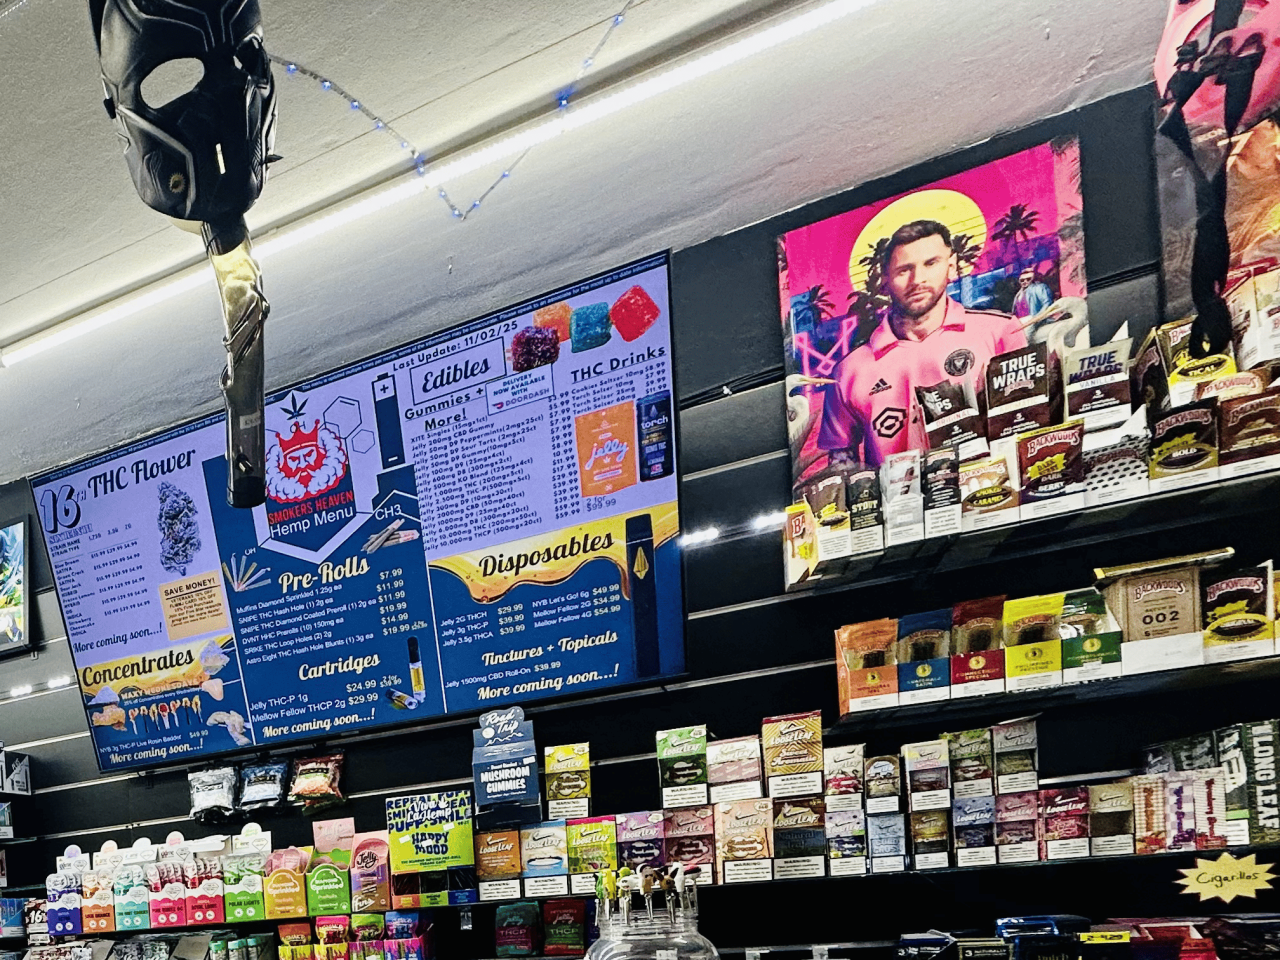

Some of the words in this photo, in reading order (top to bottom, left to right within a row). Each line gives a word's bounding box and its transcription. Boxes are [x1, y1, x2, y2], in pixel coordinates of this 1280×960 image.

[393, 360, 416, 372] Last
[418, 343, 461, 364] Update:
[464, 320, 518, 350] 11/02/25
[571, 360, 604, 383] THC
[610, 346, 666, 369] Drinks
[999, 350, 1038, 379] TRUE
[1078, 349, 1117, 371] TRUE
[422, 357, 490, 394] Edibles
[993, 361, 1046, 394] WRAPS
[404, 392, 470, 420] Gummies
[424, 408, 467, 432] More!
[1156, 409, 1212, 437] BACKWOODS
[1027, 429, 1081, 458] BACKWOODS
[87, 472, 129, 499] THC
[130, 449, 196, 486] Flower
[268, 501, 313, 524] SMOKERS
[316, 491, 354, 511] HEAVEN
[375, 504, 402, 520] CH3
[852, 500, 878, 511] STOUT
[270, 518, 311, 538] Hemp
[315, 507, 354, 524] Menu
[478, 532, 615, 577] Disposables
[164, 586, 183, 597] SAVE
[185, 577, 216, 592] MONEY!
[278, 556, 370, 593] Pre-Rolls
[376, 579, 404, 592] $11.99
[378, 590, 406, 603] $11.99
[593, 583, 620, 596] $49.99
[1133, 579, 1187, 601] BACKWOODS
[1206, 576, 1265, 601] BACKWOODS
[381, 613, 408, 626] $14.99
[1141, 610, 1180, 627] 002
[73, 637, 96, 654] More
[97, 629, 128, 649] coming
[482, 645, 544, 666] Tinctures
[557, 630, 618, 652] Topicals
[82, 648, 195, 687] Concentrates
[299, 653, 380, 681] Cartridges
[268, 695, 295, 707] THC-P
[346, 680, 376, 692] $24.99
[477, 685, 510, 701] More
[513, 678, 564, 695] coming
[252, 712, 279, 724] Mellow
[281, 705, 306, 717] Fellow
[308, 701, 332, 712] THCP
[348, 693, 378, 705] $29.99
[485, 710, 515, 727] Road
[263, 724, 289, 738] More
[291, 717, 332, 735] coming
[495, 721, 519, 734] Trip
[110, 749, 132, 764] More
[133, 744, 167, 762] coming
[1252, 724, 1276, 777] LONG
[480, 766, 530, 783] MUSHROOM
[486, 779, 527, 792] GUMMIES
[1257, 779, 1278, 829] LEAF
[412, 832, 449, 845] HAPPY
[1196, 870, 1260, 887] Cigarillos
